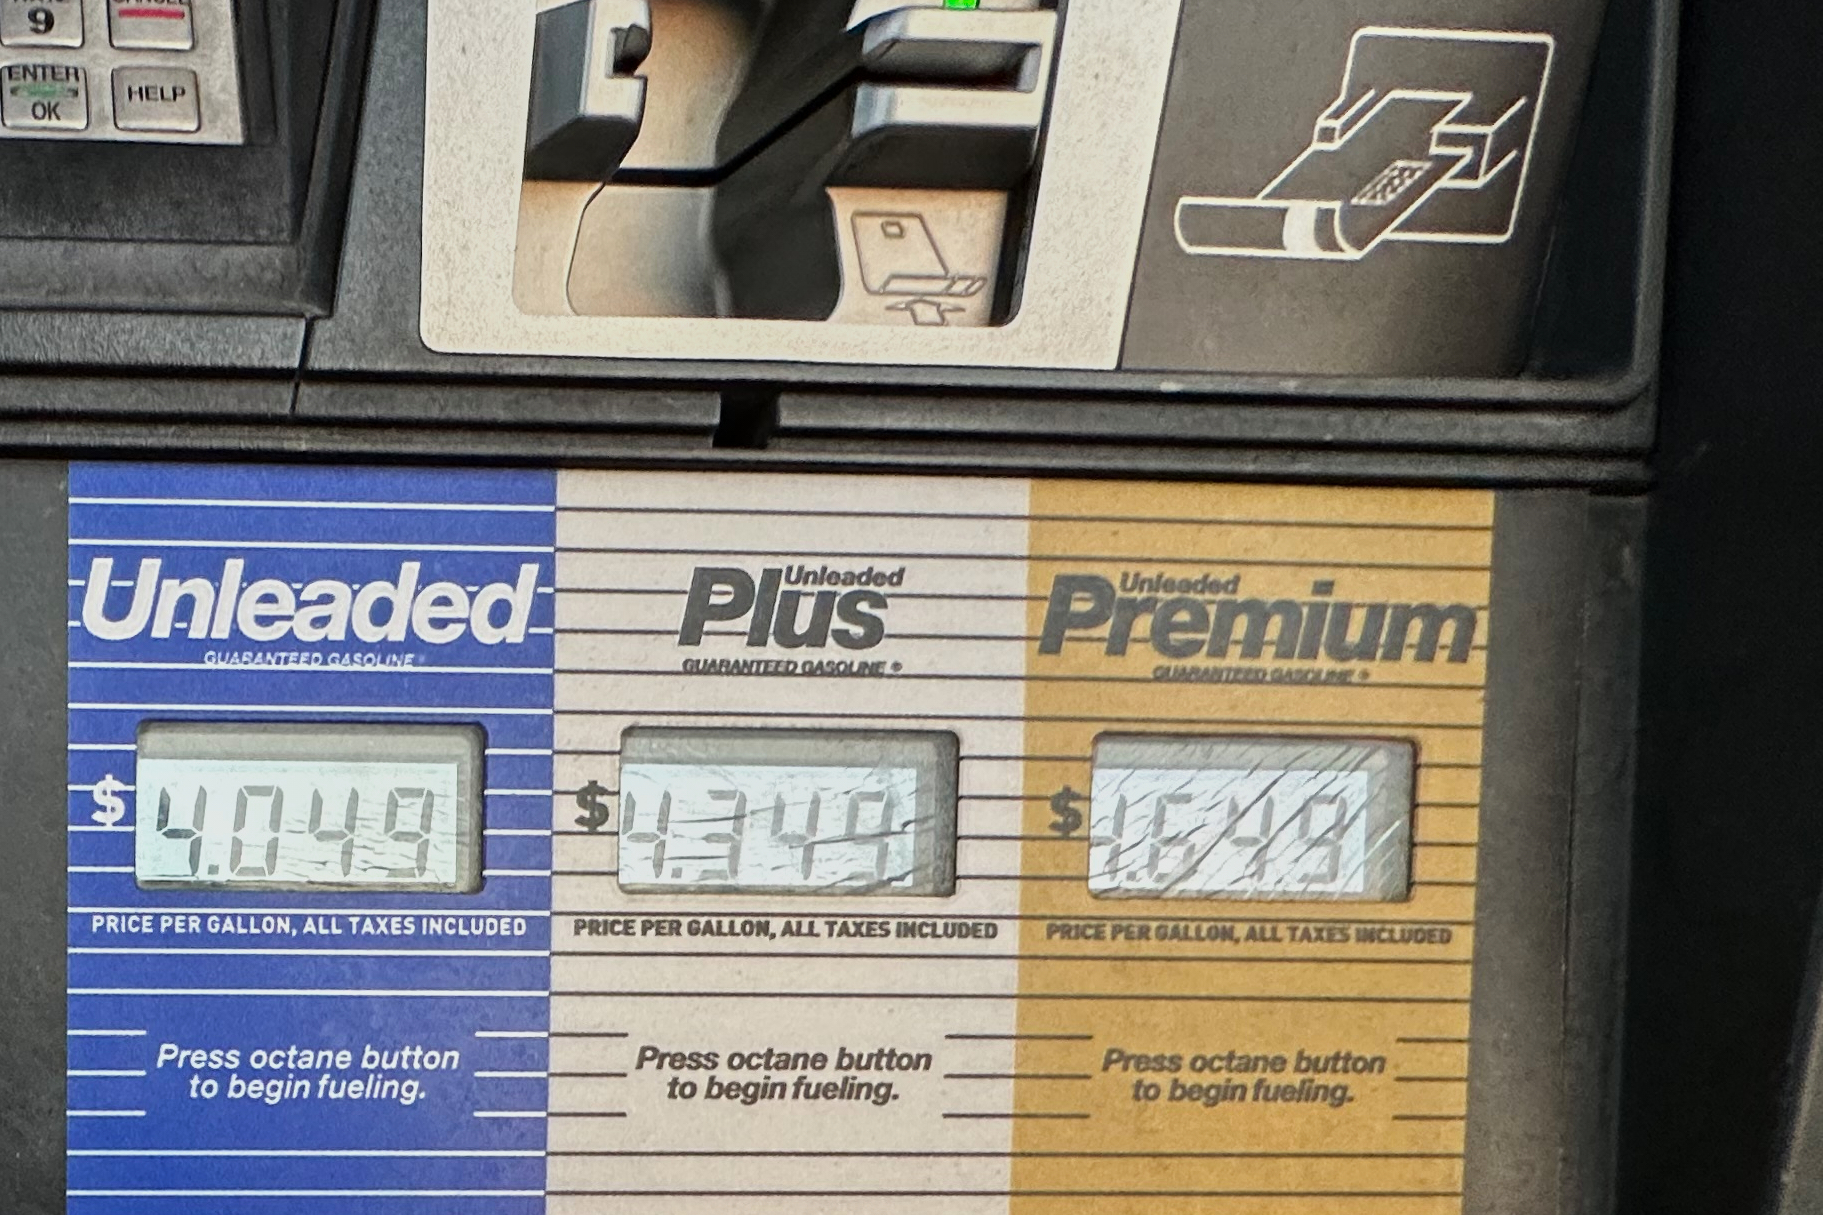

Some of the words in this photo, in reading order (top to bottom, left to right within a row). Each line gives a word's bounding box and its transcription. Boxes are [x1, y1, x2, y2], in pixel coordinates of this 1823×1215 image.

[28, 8, 54, 34] 9
[8, 65, 79, 81] ENTER
[129, 85, 185, 101] HELP
[31, 103, 61, 120] OK
[784, 565, 905, 586] Unleaded
[1119, 572, 1240, 595] Unleaded
[83, 557, 539, 644] Unleaded
[679, 566, 888, 650] Plus
[1038, 574, 1477, 663] Premium
[204, 651, 322, 665] GUARANTEED
[683, 658, 798, 675] GUARANTEED
[91, 774, 126, 827] $
[574, 779, 610, 833] $
[1048, 785, 1082, 838] $
[156, 784, 435, 878] 4.049
[92, 915, 153, 933] PRICE
[160, 916, 200, 933] PER
[207, 916, 297, 936] GALLON,
[302, 917, 342, 935] ALL
[349, 917, 415, 935] TAXES
[422, 917, 526, 936] INCLUDED
[574, 919, 635, 936] PRICE
[642, 920, 681, 937] PER
[687, 920, 775, 940] GALLON,
[781, 920, 820, 938] ALL
[827, 920, 890, 938] TAXES
[896, 921, 998, 939] INCLUDED
[1047, 923, 1106, 940] PRICE
[1111, 924, 1151, 941] PER
[1245, 924, 1282, 942] ALL
[1288, 925, 1349, 943] TAXES
[1356, 926, 1452, 944] INCLUDED
[157, 1043, 240, 1069] Press
[250, 1045, 352, 1069] octane
[361, 1044, 459, 1069] button
[636, 1045, 719, 1070] Press
[727, 1048, 828, 1070] octane
[835, 1047, 932, 1071] button
[1102, 1048, 1182, 1072] Press
[1189, 1050, 1286, 1072] octane
[1294, 1049, 1386, 1074] button
[189, 1074, 218, 1098] to
[227, 1074, 310, 1104] begin
[317, 1074, 426, 1105] fueling.
[667, 1076, 697, 1100] to
[704, 1075, 787, 1105] begin
[792, 1075, 899, 1106] fueling.
[1132, 1078, 1161, 1102] to
[1168, 1078, 1247, 1108] begin
[1252, 1078, 1354, 1108] fueling.
